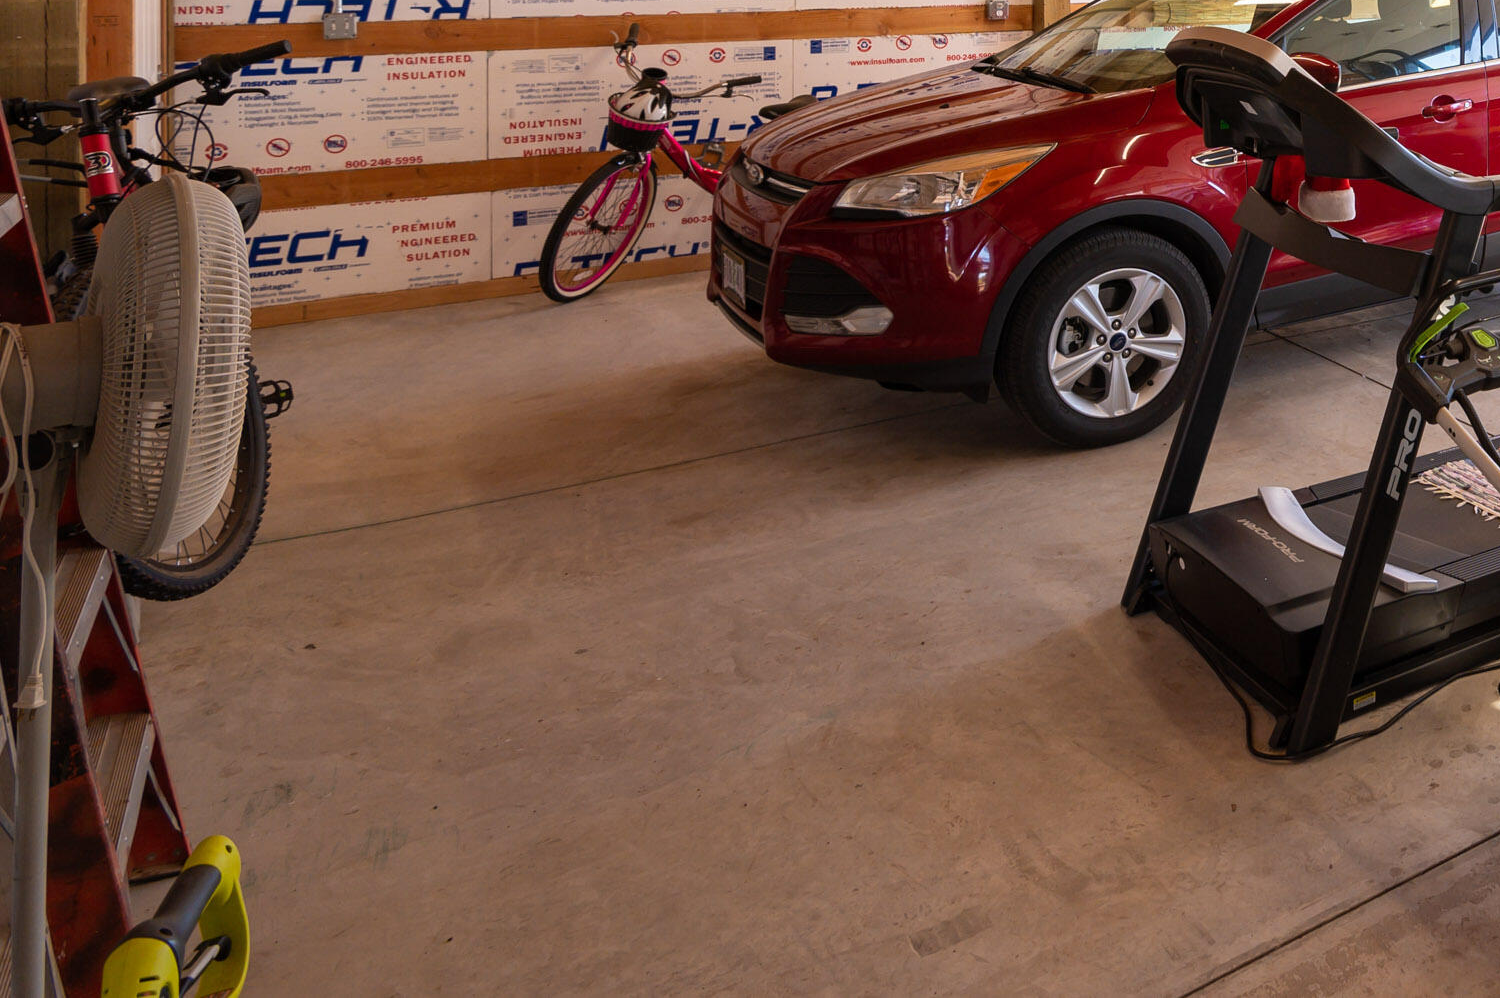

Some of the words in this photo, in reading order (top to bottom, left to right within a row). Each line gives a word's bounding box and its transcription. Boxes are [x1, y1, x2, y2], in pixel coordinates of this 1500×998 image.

[387, 54, 472, 66] ENGINEERED
[850, 56, 925, 67] www.insulfoam.com
[387, 69, 467, 81] INSULATION
[509, 117, 583, 130] INSULATION
[504, 132, 583, 144] ENGINEERED
[523, 145, 583, 158] PREMIUM
[345, 155, 424, 169] 800-248-5995
[252, 163, 312, 175] lfoam.com
[391, 220, 457, 234] PREMIUM
[400, 232, 477, 248] NGINEERED
[406, 248, 471, 262] SULATION
[1385, 408, 1422, 501] PRO
